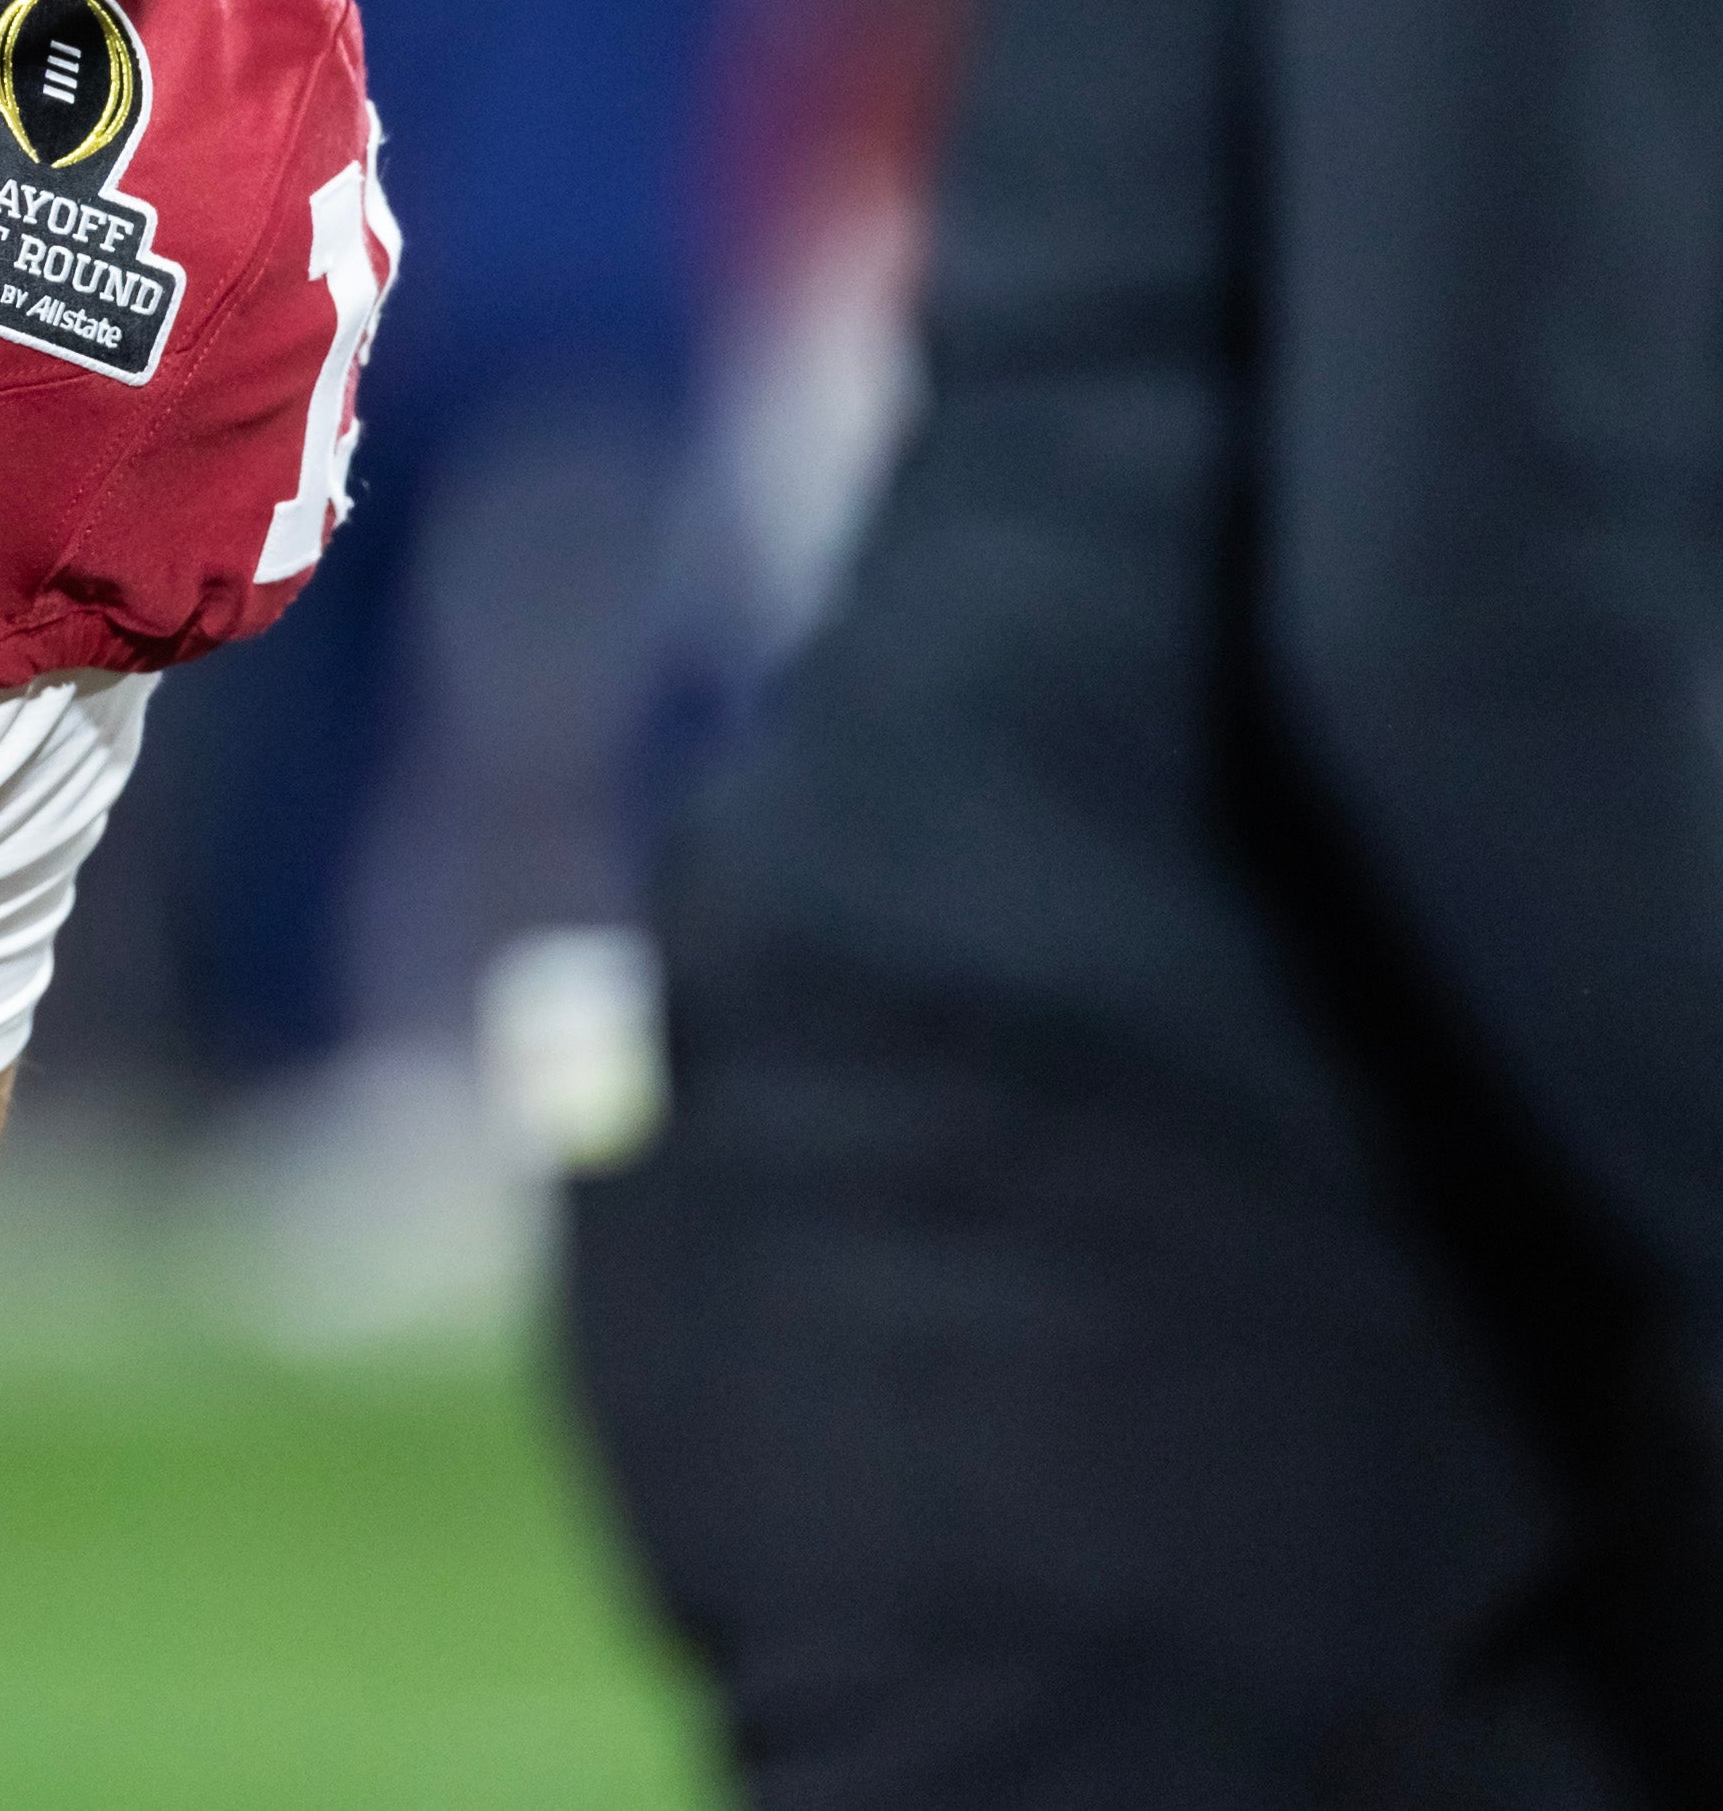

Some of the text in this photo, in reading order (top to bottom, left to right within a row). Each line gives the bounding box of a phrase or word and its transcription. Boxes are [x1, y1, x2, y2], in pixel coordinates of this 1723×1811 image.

[13, 233, 164, 316] ROUND
[0, 284, 29, 309] BY
[26, 294, 123, 349] Allstate
[253, 99, 404, 584] 1
